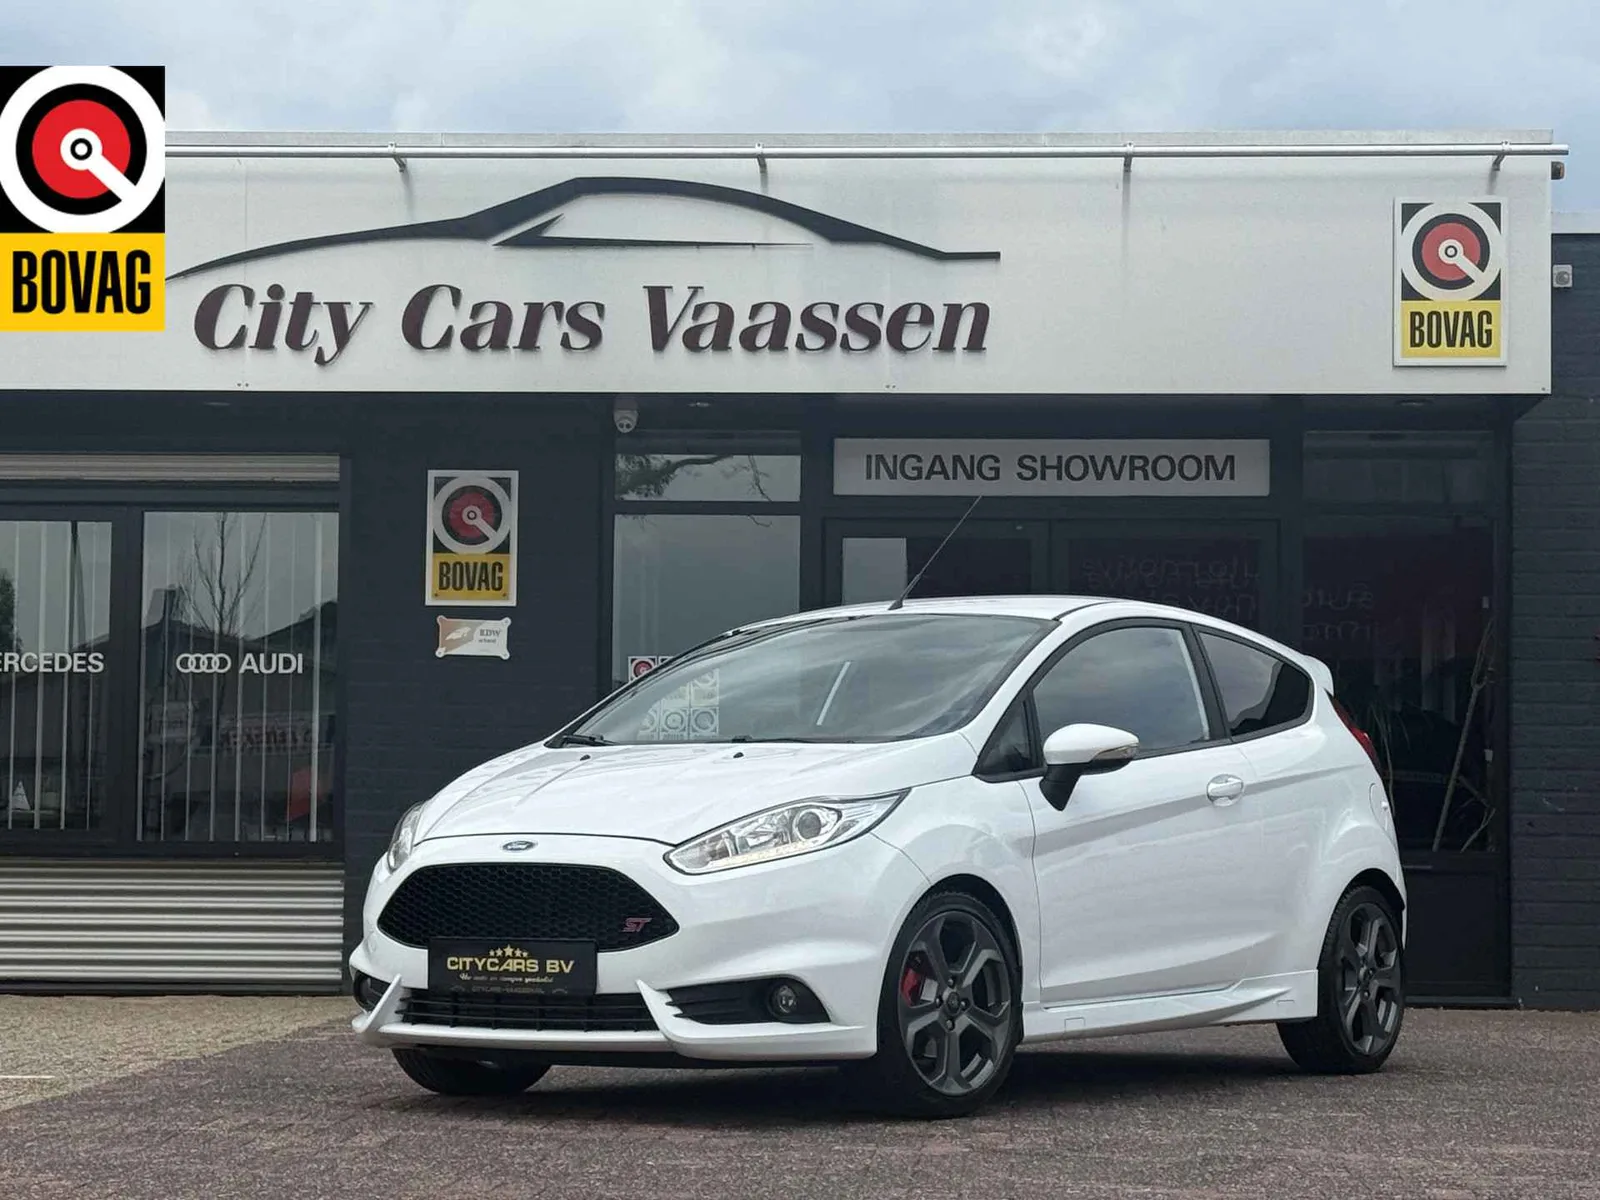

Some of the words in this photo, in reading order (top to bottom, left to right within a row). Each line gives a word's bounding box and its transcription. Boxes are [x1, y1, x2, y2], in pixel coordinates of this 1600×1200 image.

[194, 283, 373, 366] City
[402, 284, 606, 351] Cars
[643, 285, 990, 352] Vaassen
[1409, 310, 1493, 348] BOVAG
[865, 454, 1001, 481] INGANG
[1016, 454, 1236, 481] SHOWROOM
[438, 561, 504, 592] BOVAG
[0, 652, 105, 673] RCEDES
[239, 652, 304, 674] AUDI
[621, 917, 653, 933] ST
[446, 957, 540, 973] CITYCARS
[546, 960, 575, 974] BV
